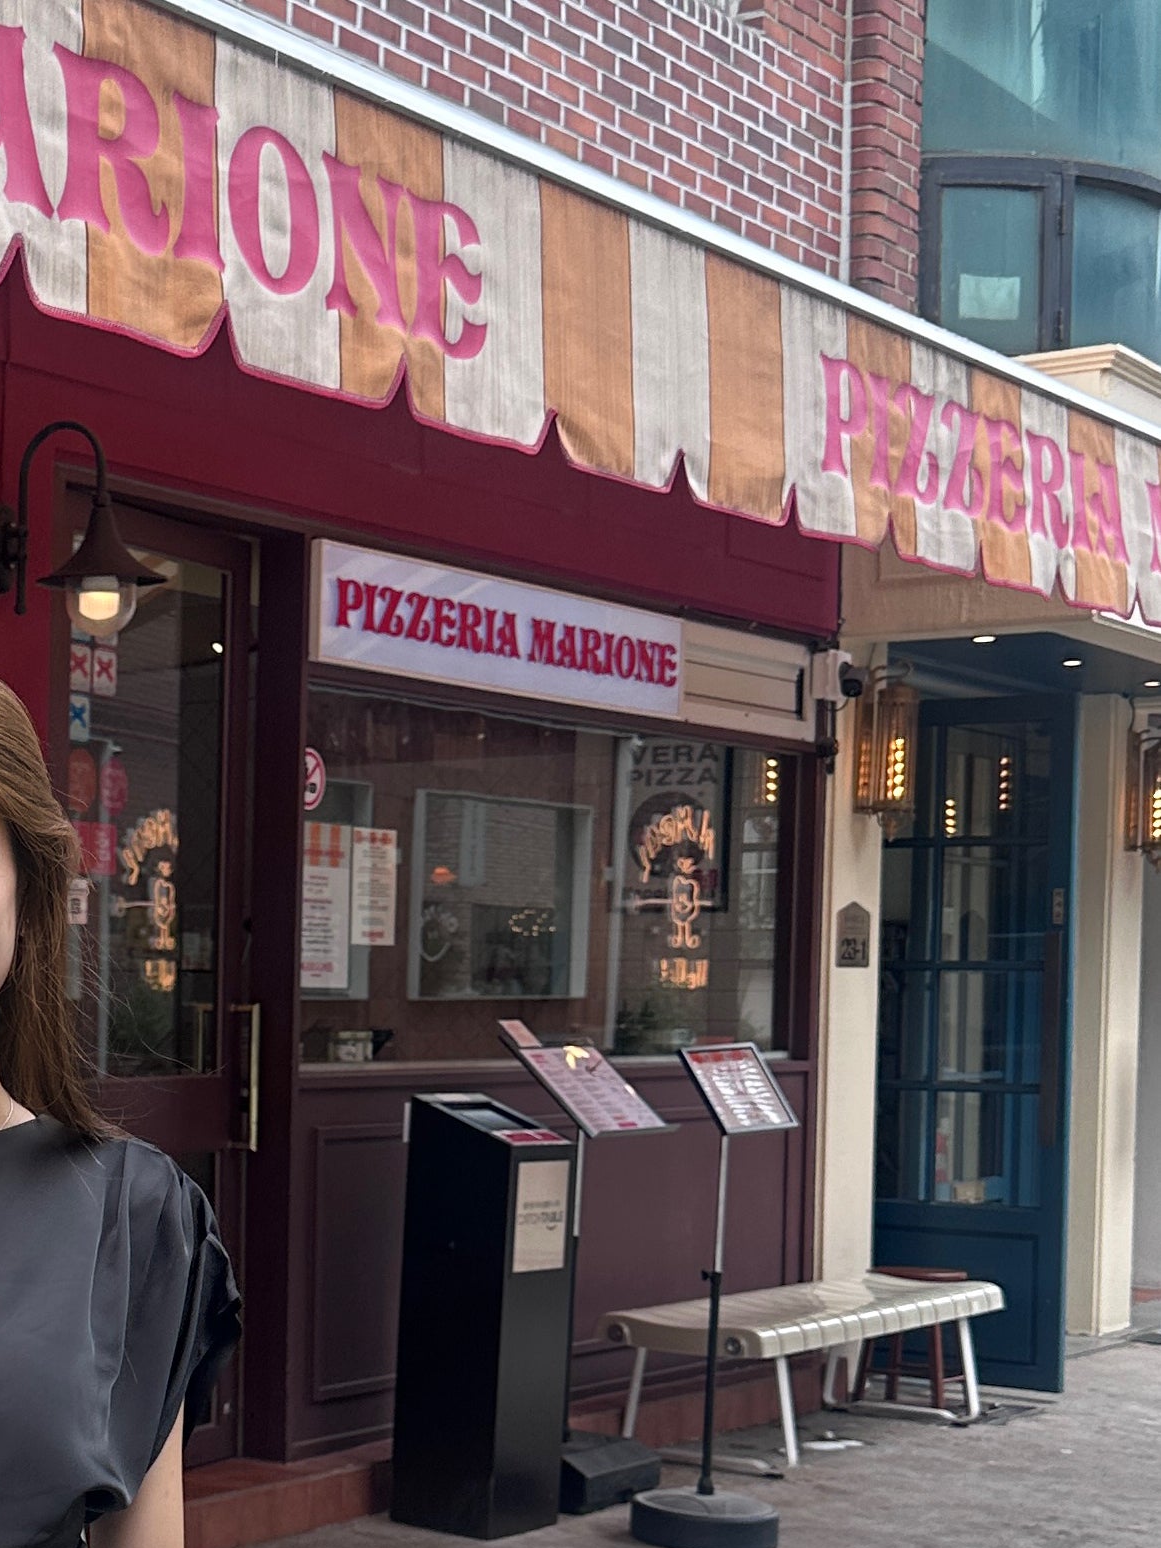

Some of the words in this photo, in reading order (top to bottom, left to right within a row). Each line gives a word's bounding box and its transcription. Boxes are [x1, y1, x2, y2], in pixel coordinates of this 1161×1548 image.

[820, 353, 1130, 566] PIZZERIA
[335, 577, 522, 660] PIZZERIA
[527, 616, 678, 688] MARIONE
[629, 767, 719, 787] PIZZA
